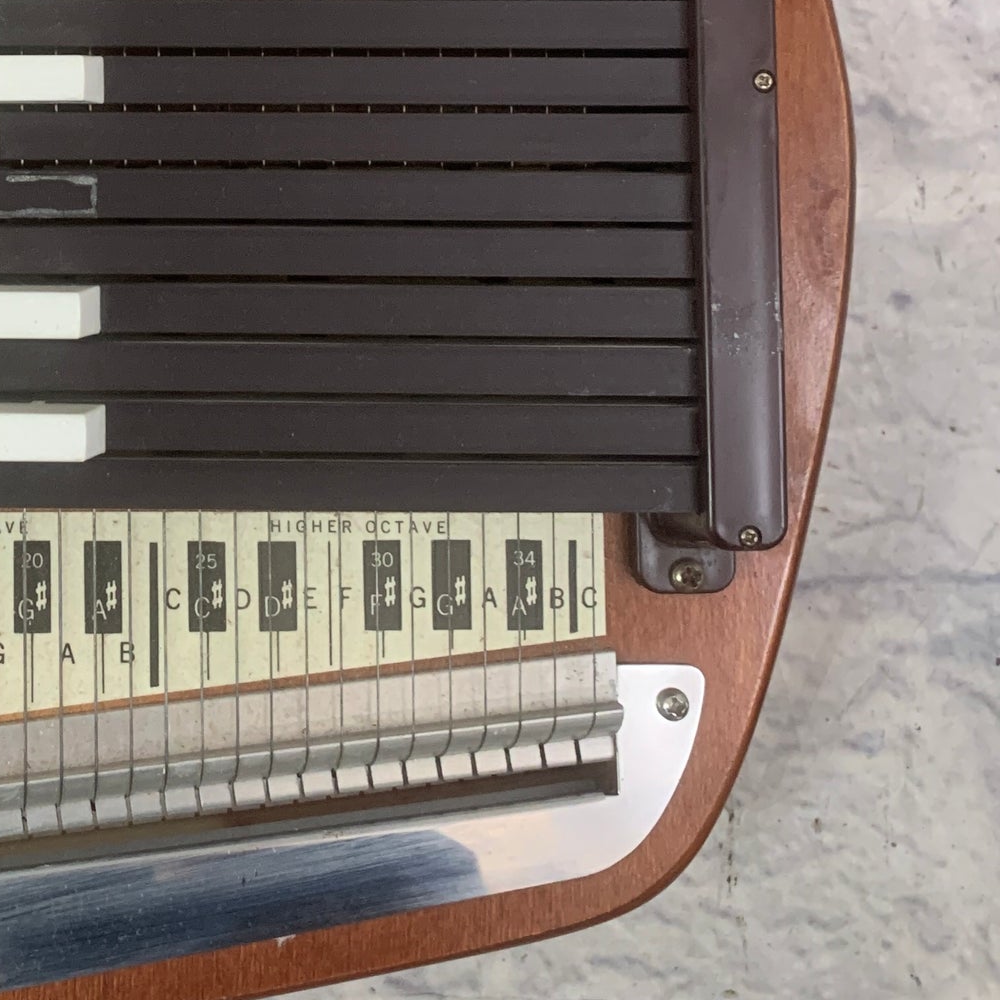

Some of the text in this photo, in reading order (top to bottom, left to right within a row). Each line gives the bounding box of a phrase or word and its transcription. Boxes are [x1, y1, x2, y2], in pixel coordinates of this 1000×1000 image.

[270, 520, 448, 535] HIGHER OCTAVE
[21, 552, 44, 569] 20
[194, 552, 218, 570] 25
[371, 551, 394, 568] 30
[513, 550, 537, 567] 34
[165, 586, 597, 610] C D E F G A B C
[60, 642, 76, 665] A
[120, 641, 135, 664] B
